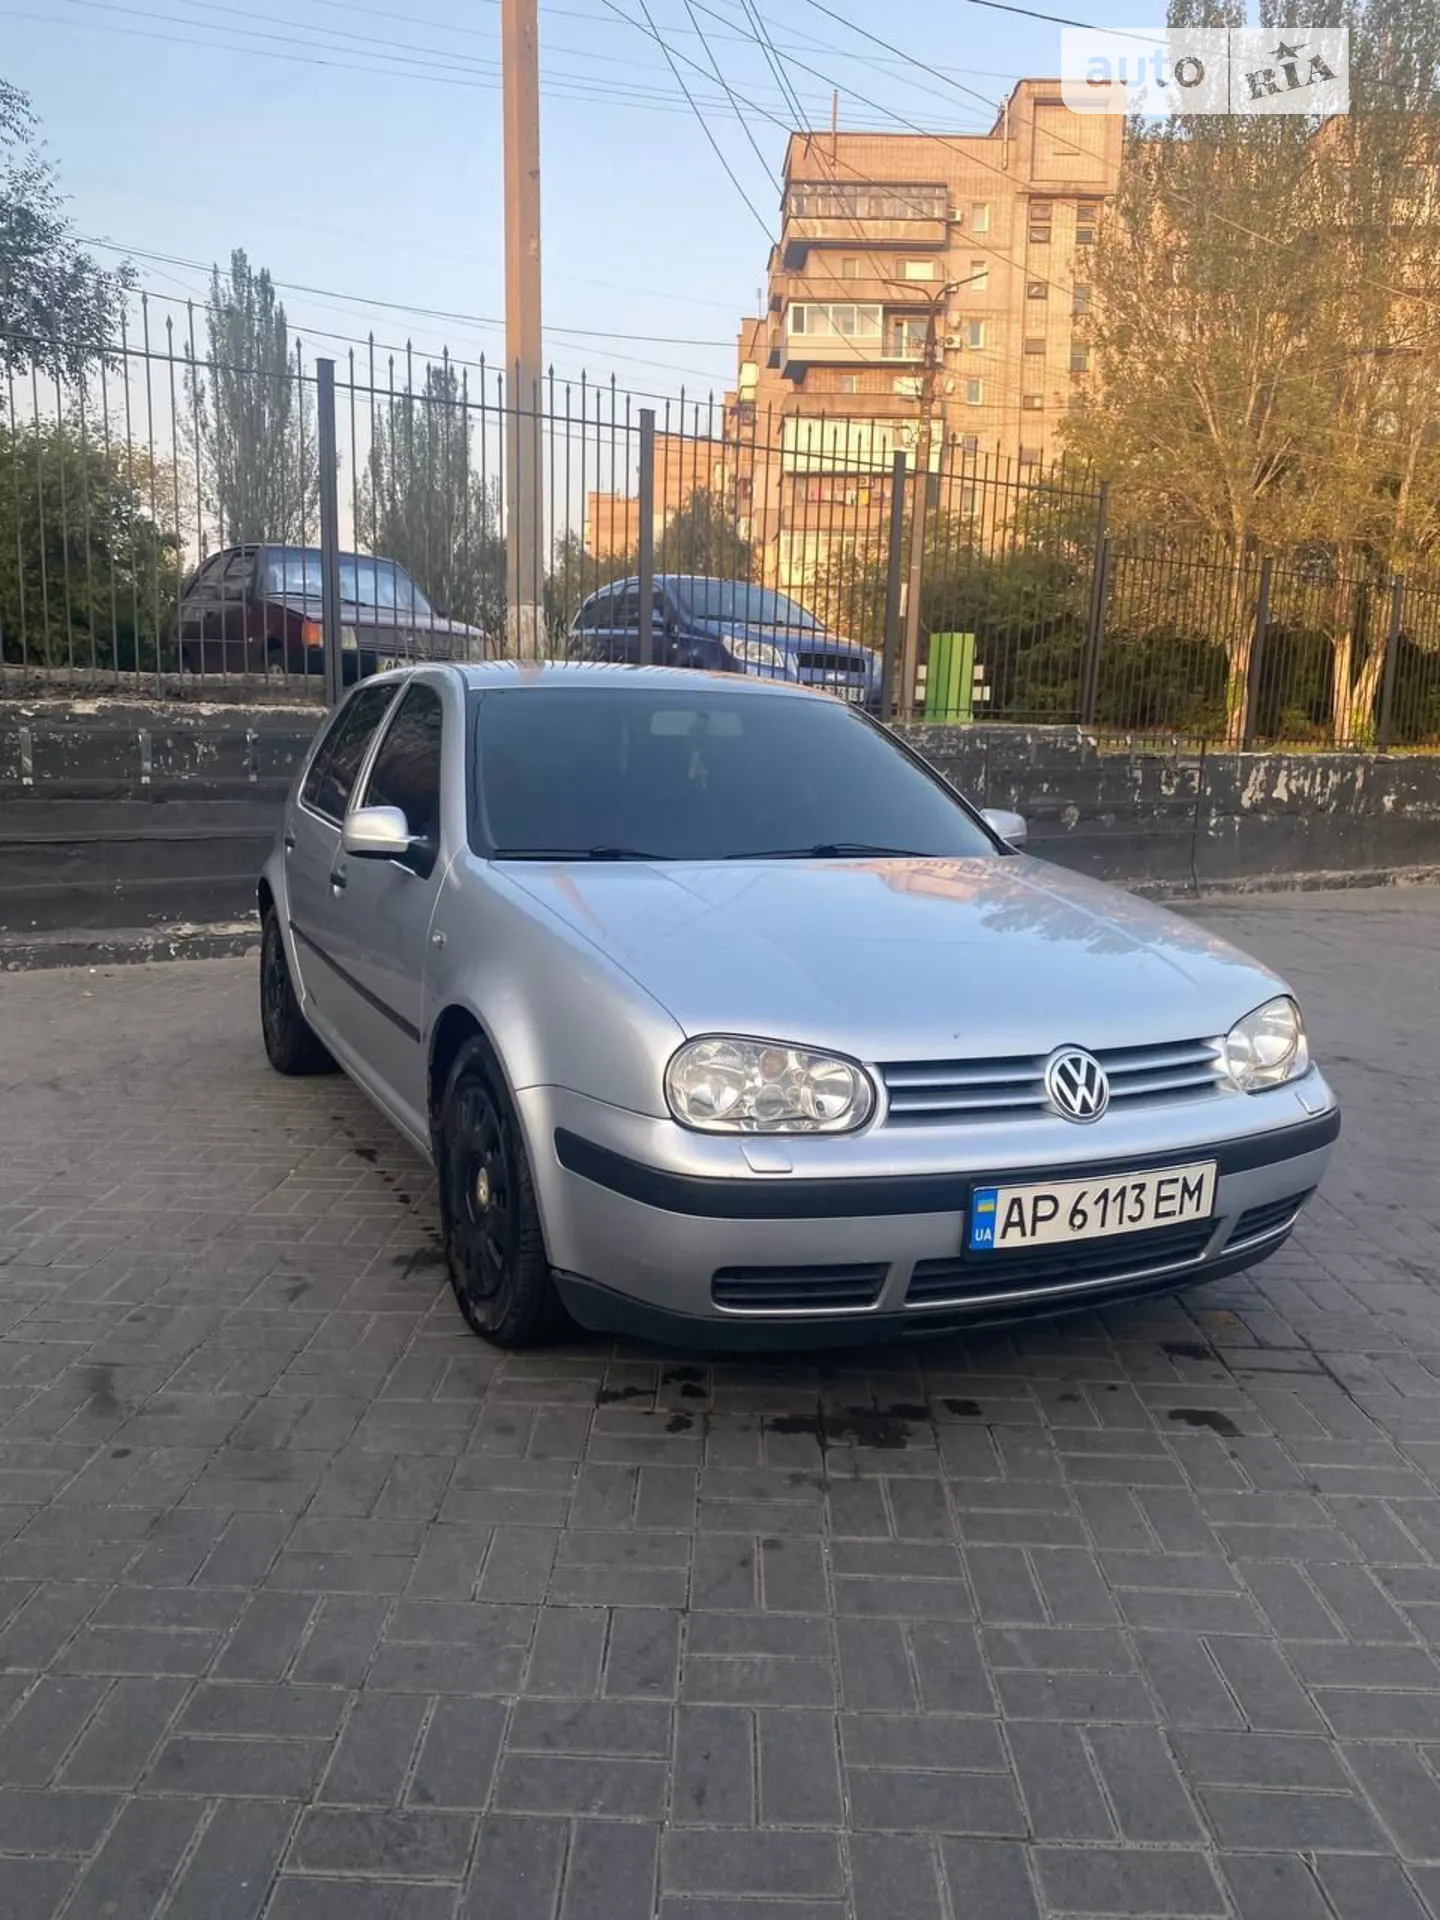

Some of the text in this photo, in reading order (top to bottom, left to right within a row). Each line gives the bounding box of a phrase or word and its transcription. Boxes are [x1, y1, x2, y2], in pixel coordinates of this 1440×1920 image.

[1000, 1173, 1204, 1240] AP 6113 EM
[974, 1227, 993, 1242] UA
